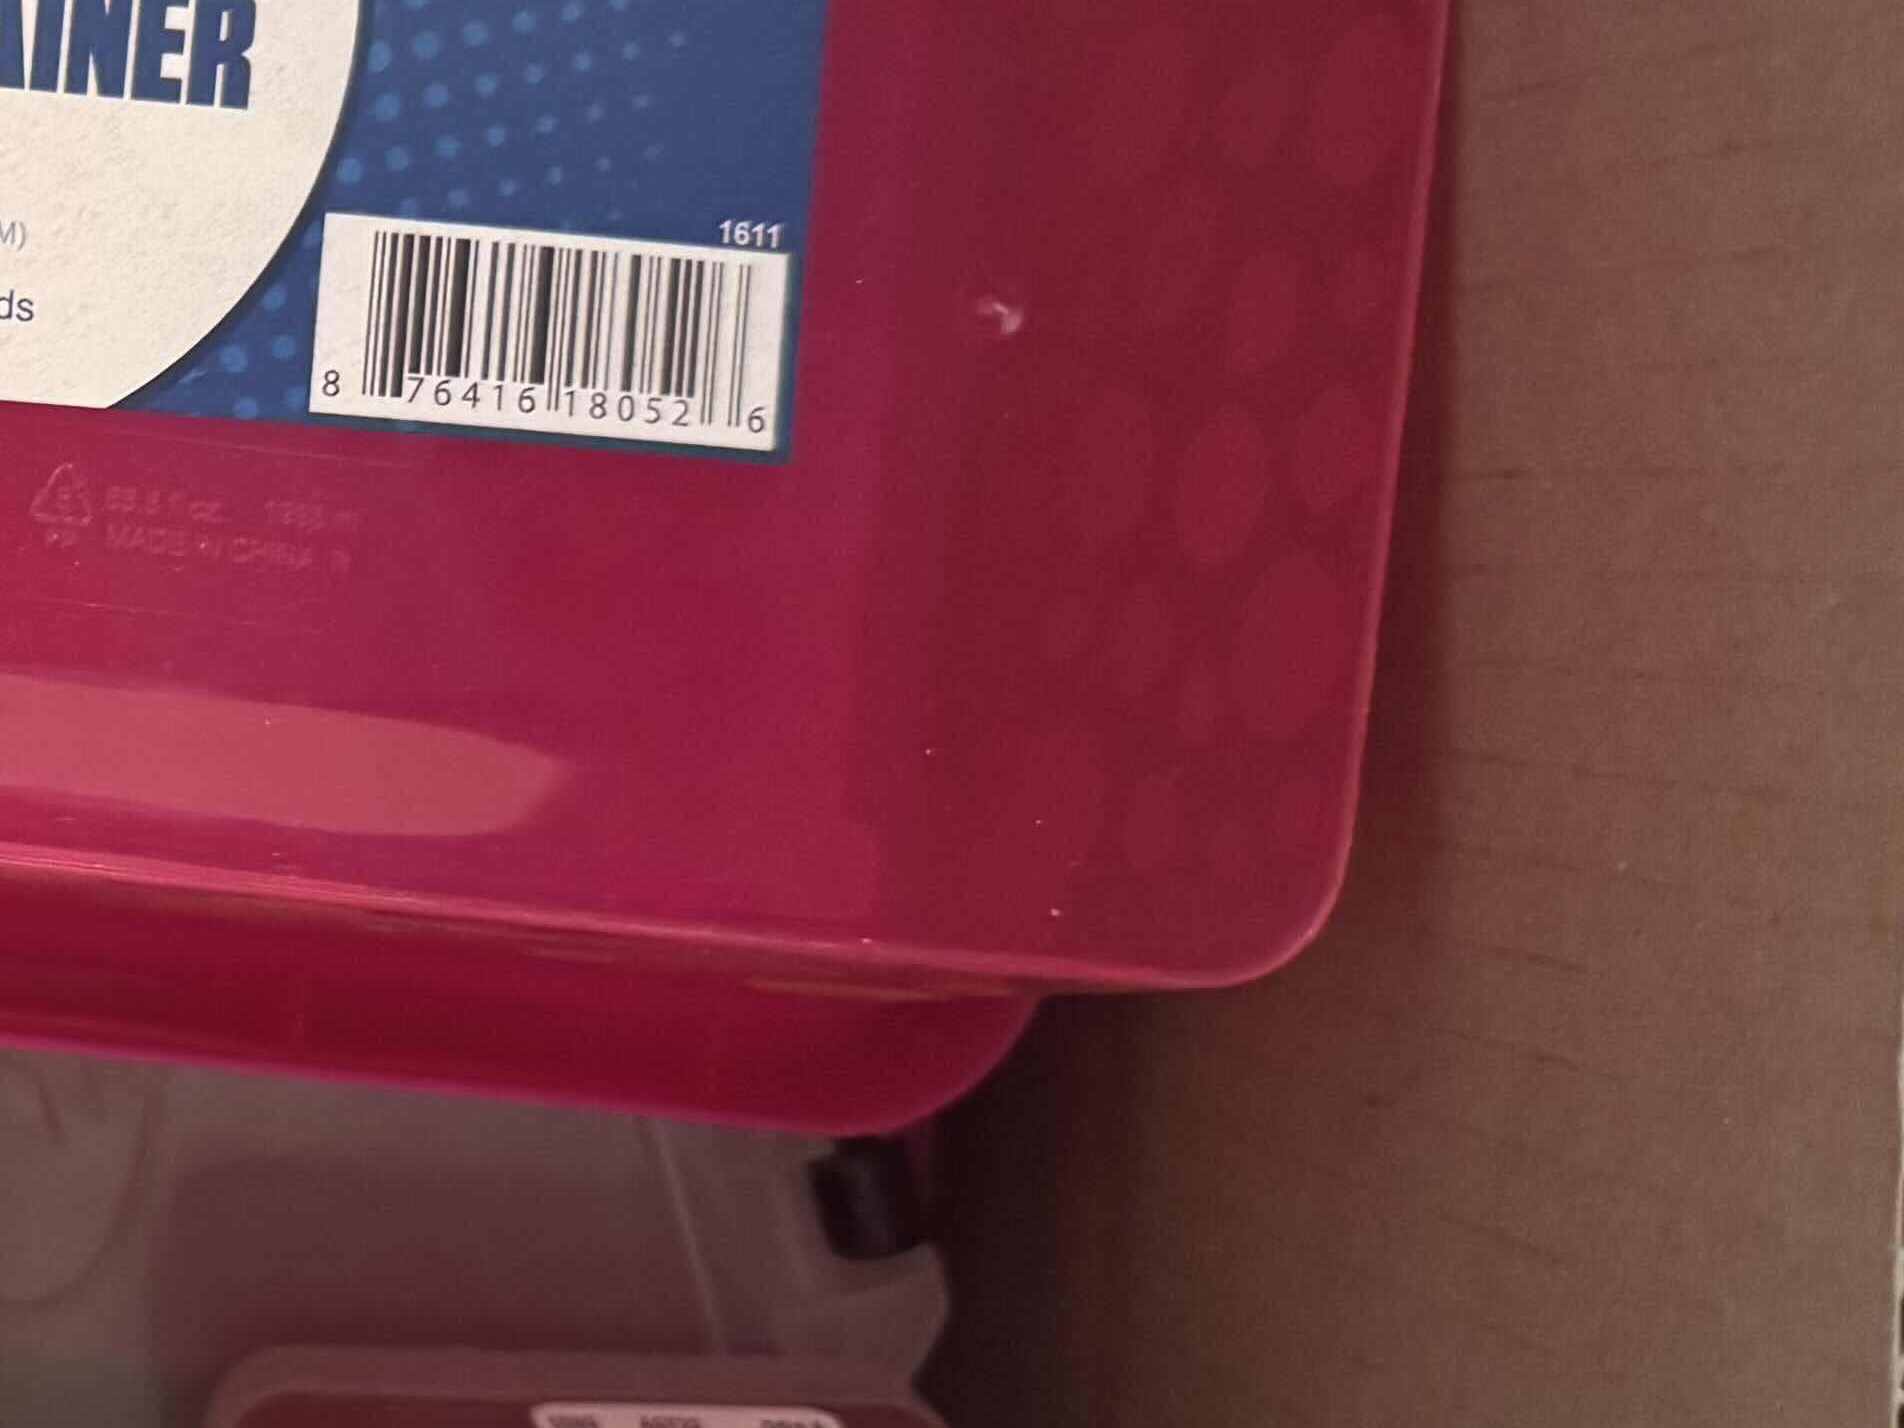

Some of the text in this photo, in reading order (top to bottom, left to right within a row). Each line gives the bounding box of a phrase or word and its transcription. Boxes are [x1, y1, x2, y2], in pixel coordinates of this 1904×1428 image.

[719, 219, 783, 249] 1611
[321, 370, 765, 434] 8 76416 18052 6
